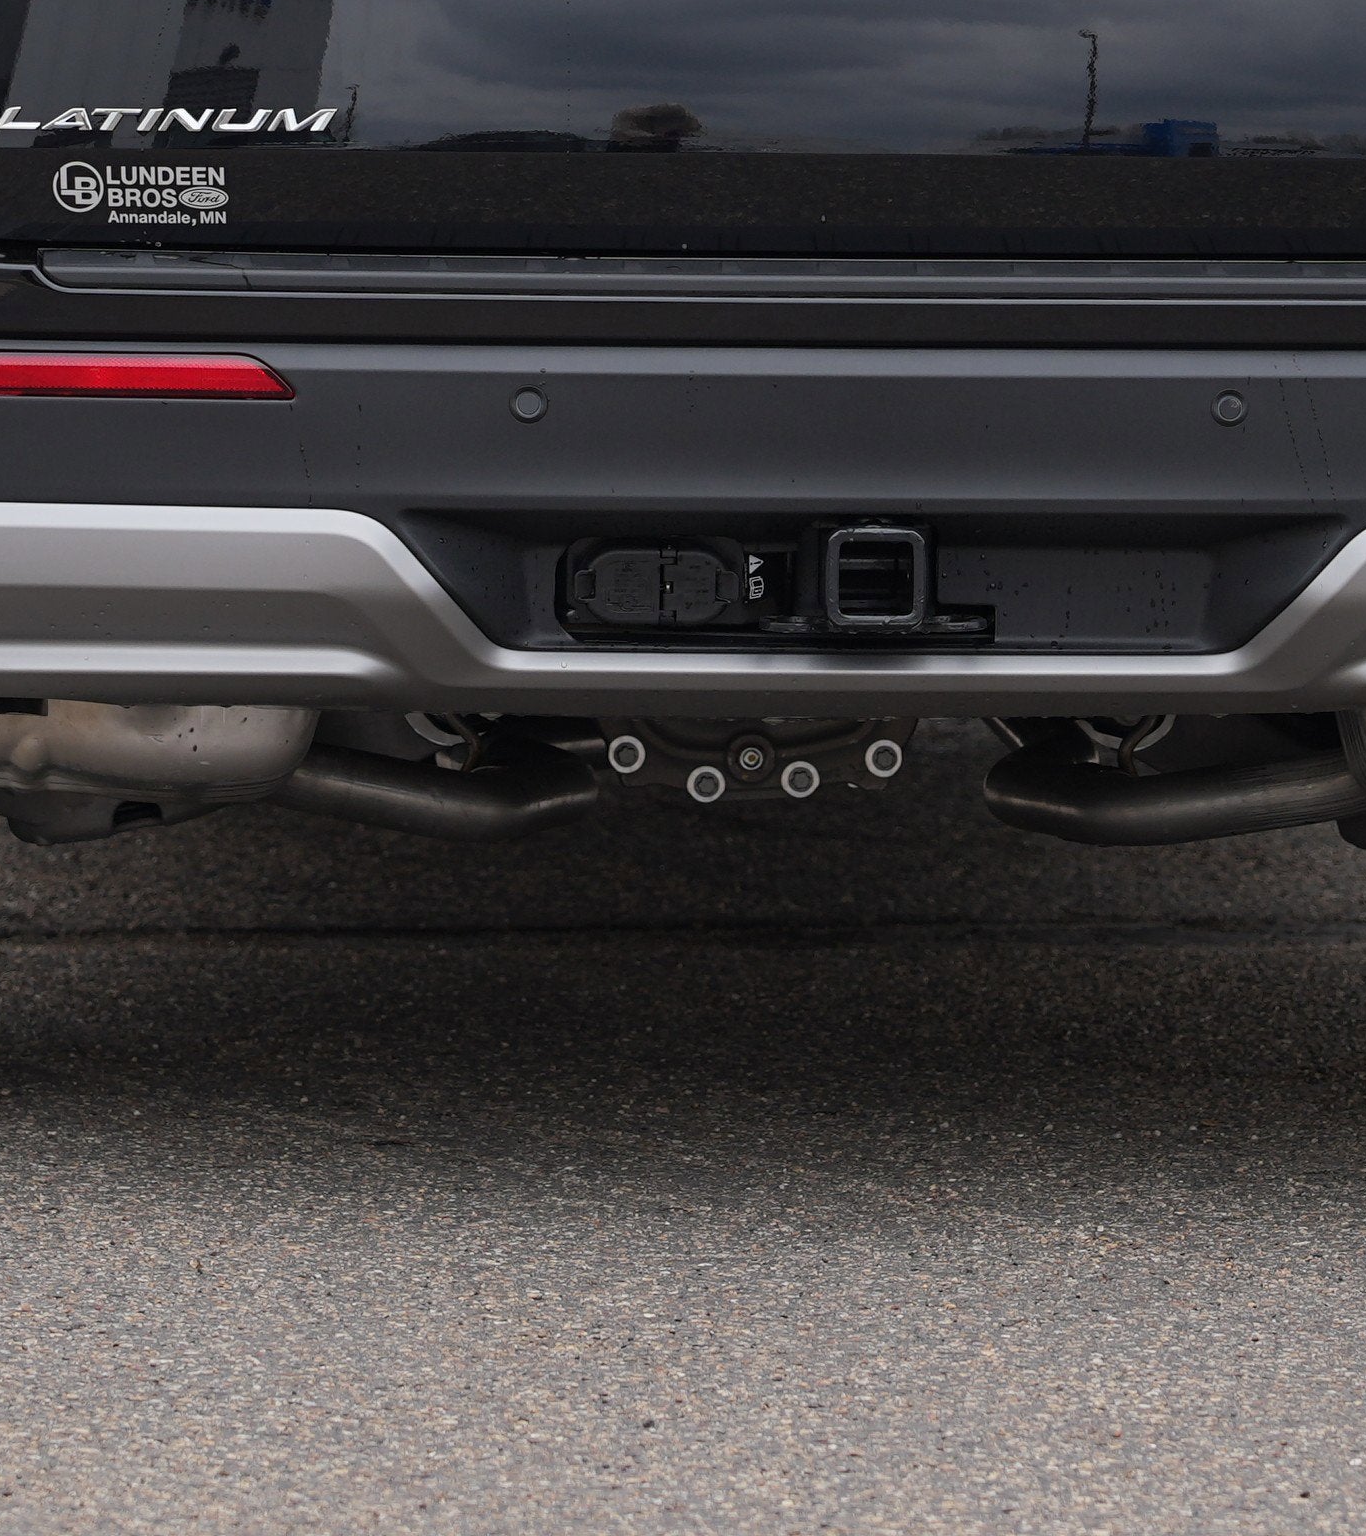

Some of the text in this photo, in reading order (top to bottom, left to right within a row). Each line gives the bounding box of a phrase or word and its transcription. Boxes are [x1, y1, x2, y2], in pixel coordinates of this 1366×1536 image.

[106, 165, 225, 186] LUNDEEN
[107, 188, 178, 208] BROS
[107, 210, 227, 226] Annandale, MN
